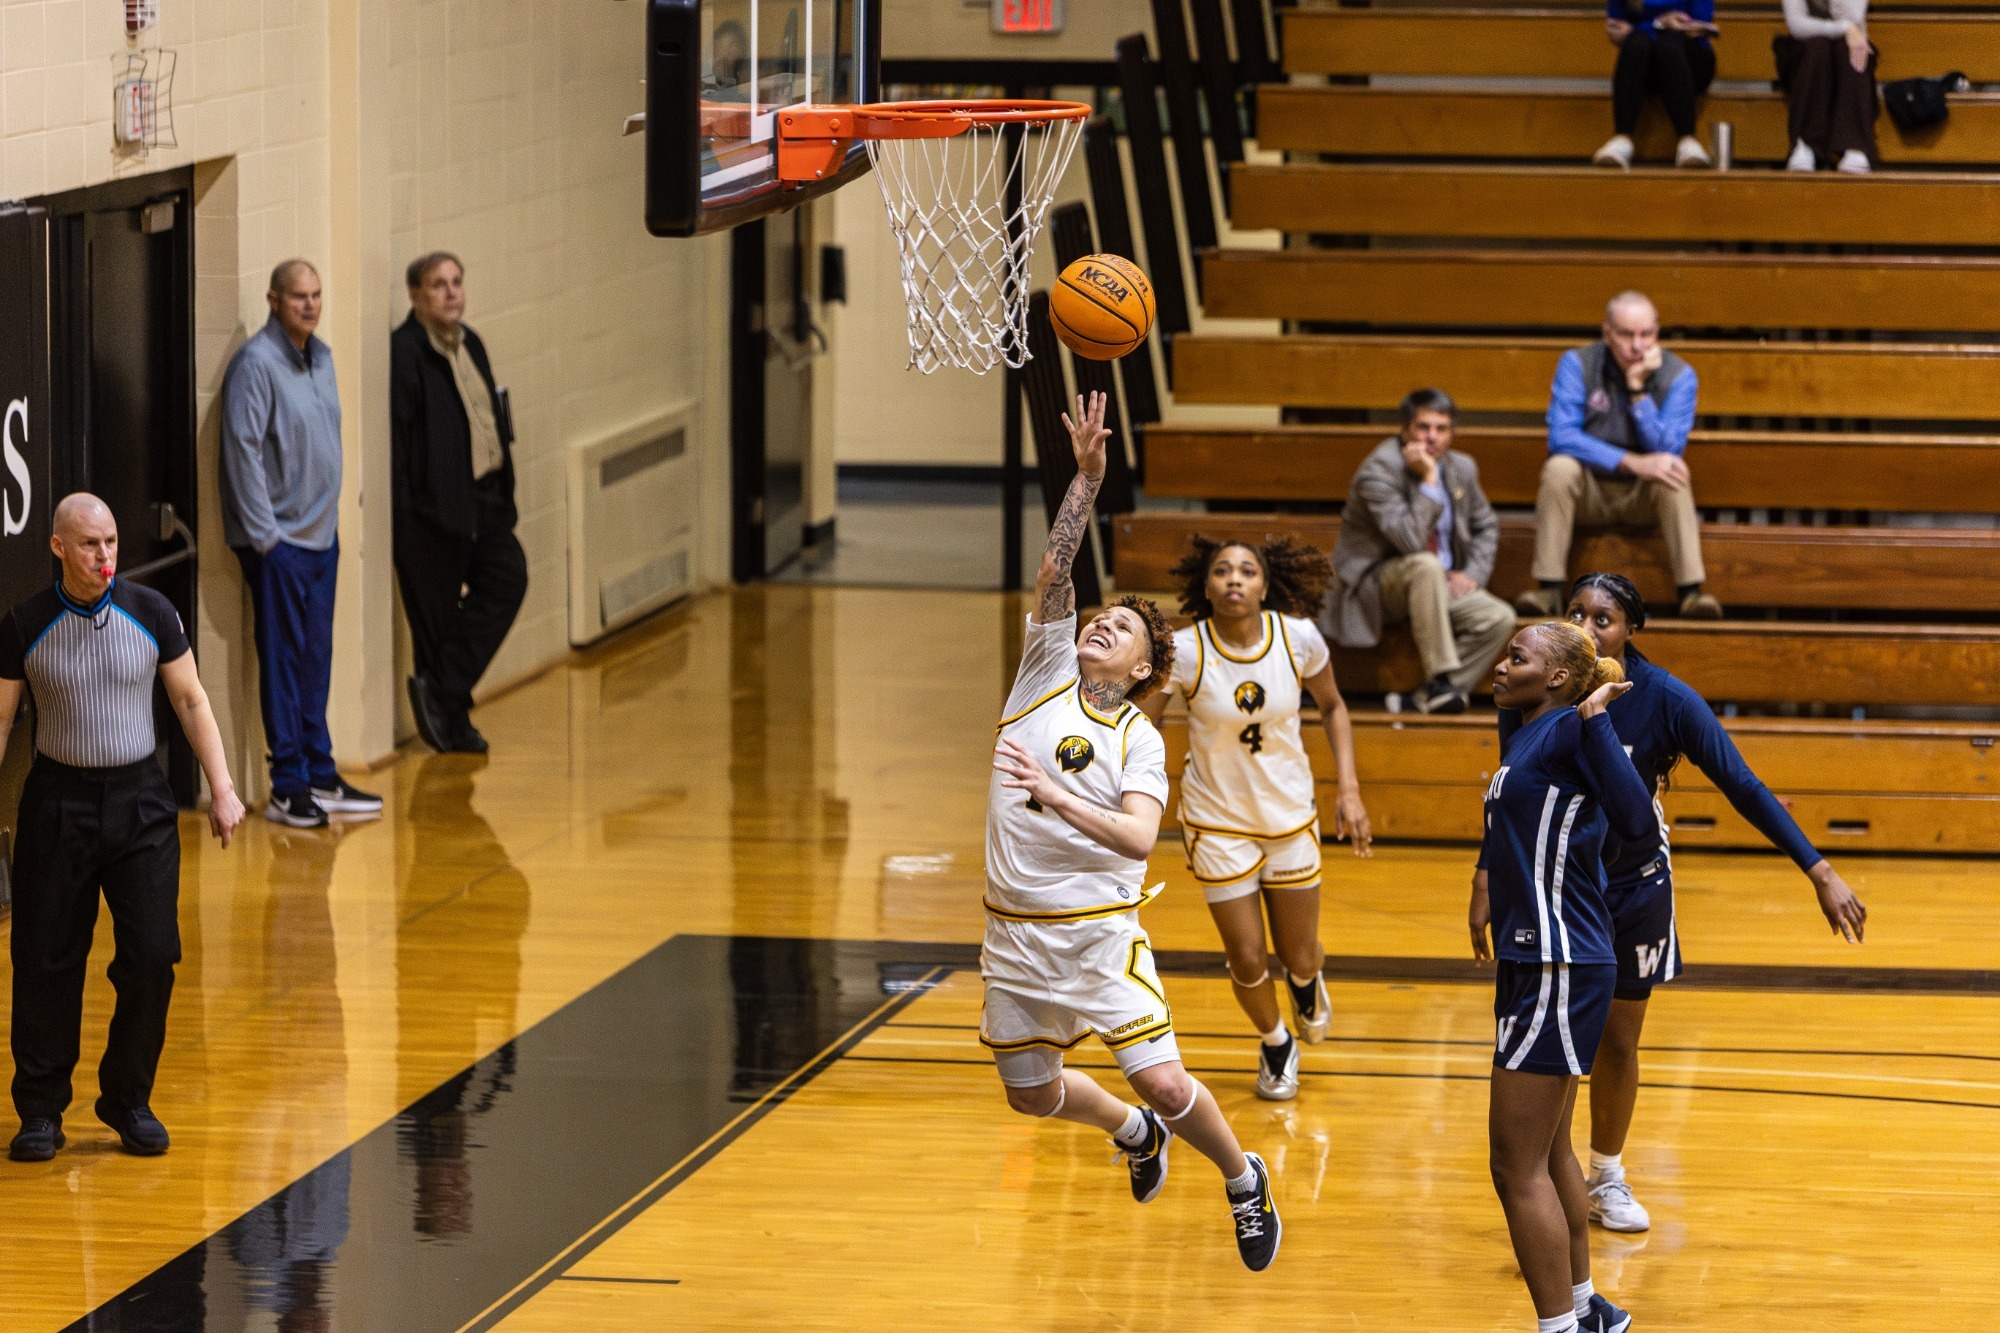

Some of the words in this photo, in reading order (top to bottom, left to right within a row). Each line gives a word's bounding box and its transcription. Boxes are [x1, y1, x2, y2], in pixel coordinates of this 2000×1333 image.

[1079, 265, 1129, 303] NCAA
[3, 395, 32, 537] S
[1239, 722, 1263, 755] 4
[1635, 937, 1667, 979] W
